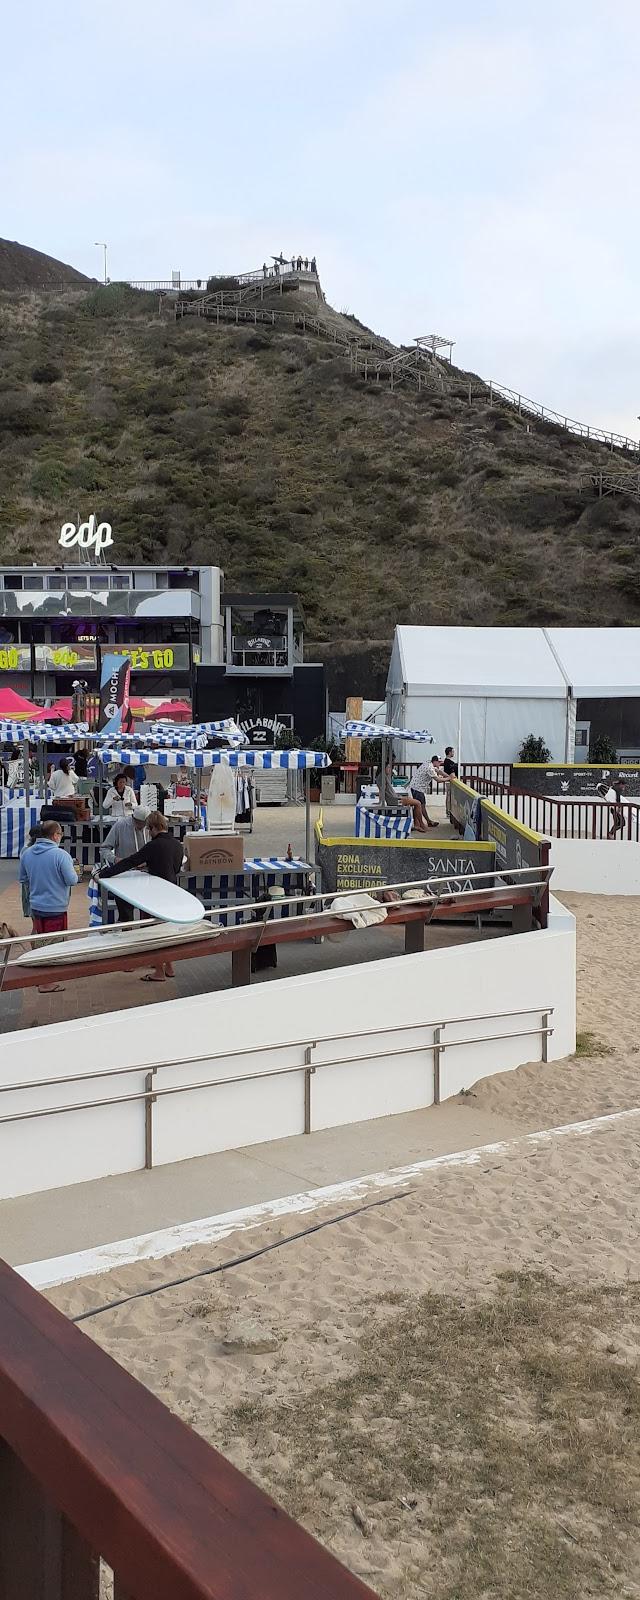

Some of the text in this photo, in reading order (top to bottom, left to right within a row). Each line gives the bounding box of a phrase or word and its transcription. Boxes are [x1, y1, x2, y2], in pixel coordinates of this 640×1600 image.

[58, 514, 114, 556] edp
[152, 648, 174, 669] GO
[109, 666, 120, 702] MOCHE
[601, 770, 610, 780] P
[199, 857, 233, 865] RAINBOW
[337, 854, 360, 864] ZONA
[337, 864, 382, 874] EXCLUSIVA
[427, 857, 476, 874] SANTA
[336, 879, 387, 889] MOBILIDADE
